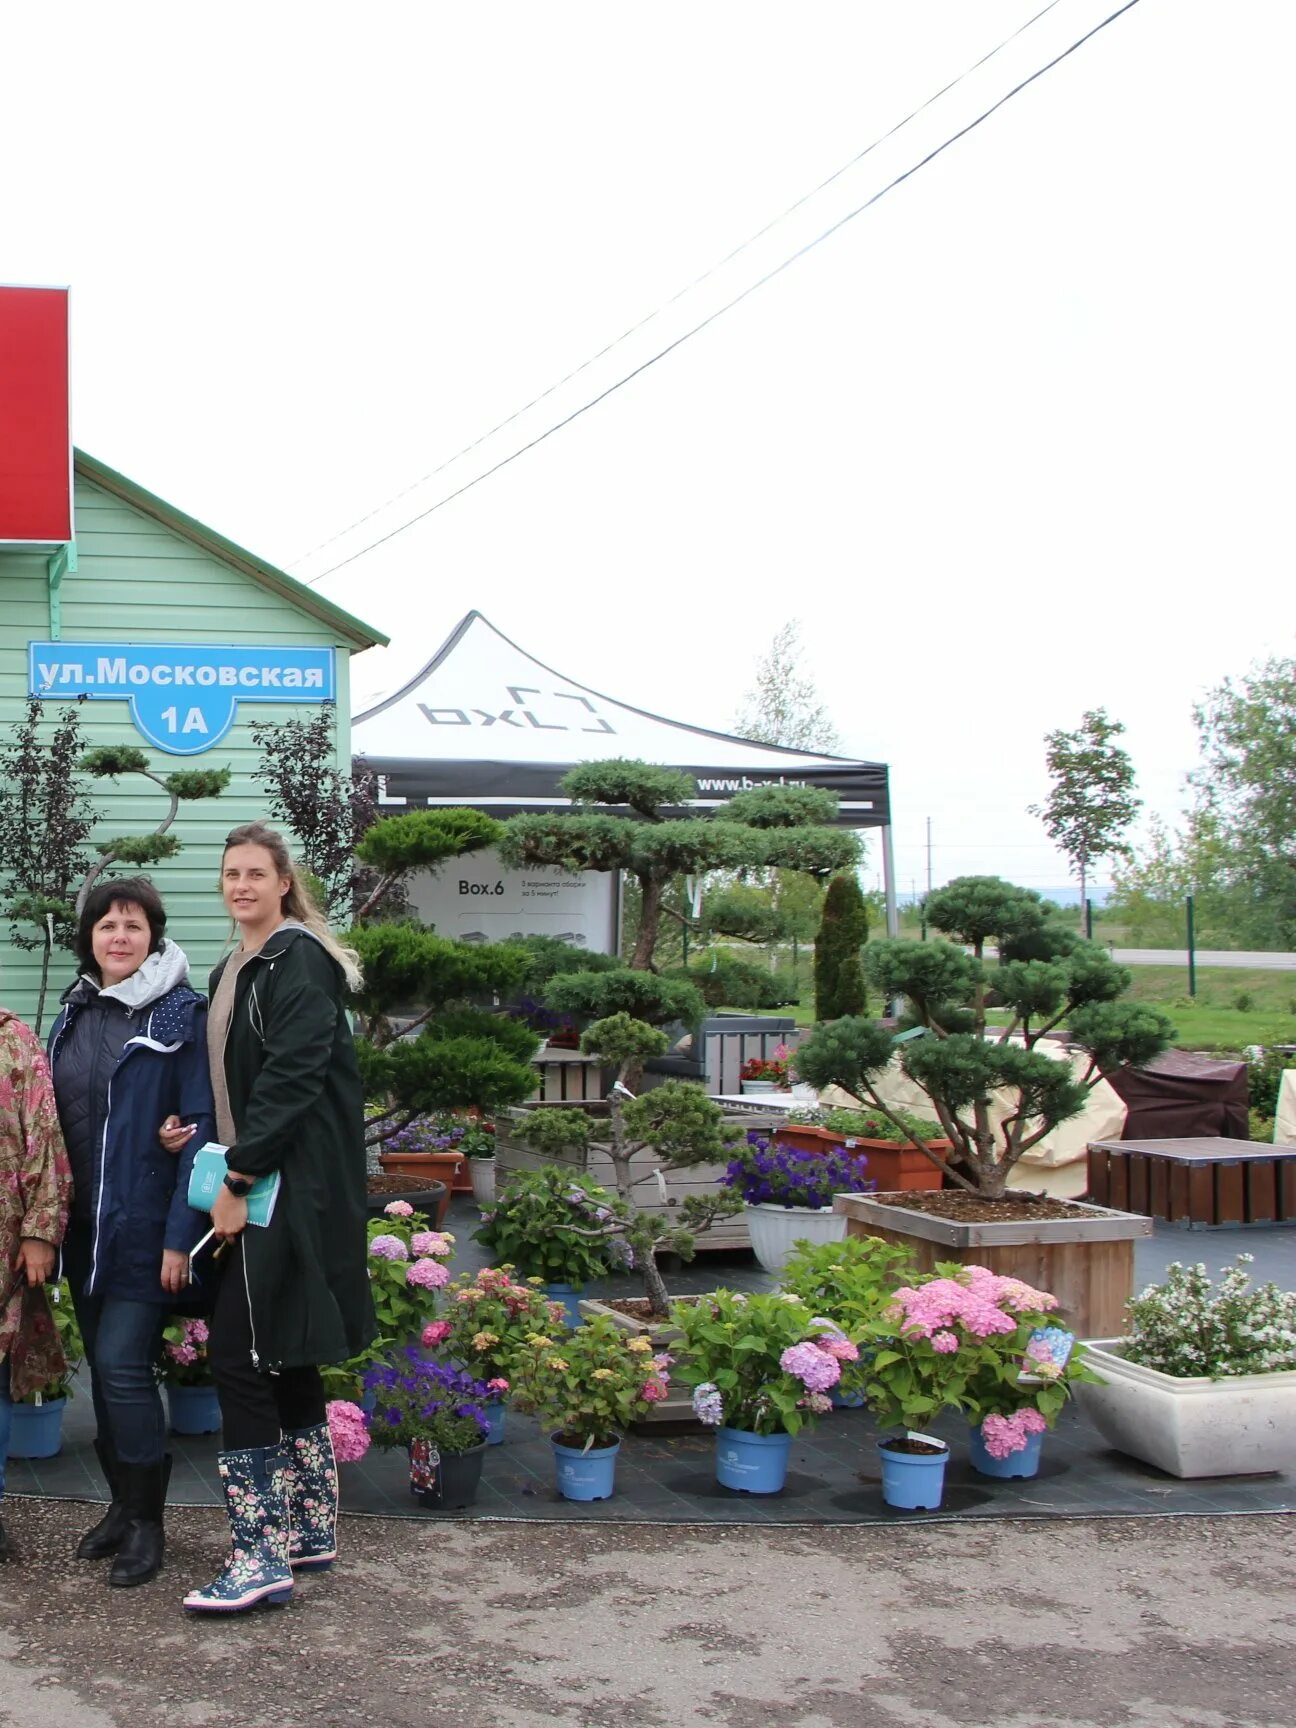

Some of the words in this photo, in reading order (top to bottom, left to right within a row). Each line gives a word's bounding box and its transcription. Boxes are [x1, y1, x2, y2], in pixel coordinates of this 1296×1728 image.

[38, 657, 324, 690] ул.Московская
[160, 706, 209, 734] 1А
[458, 880, 504, 895] Box.6
